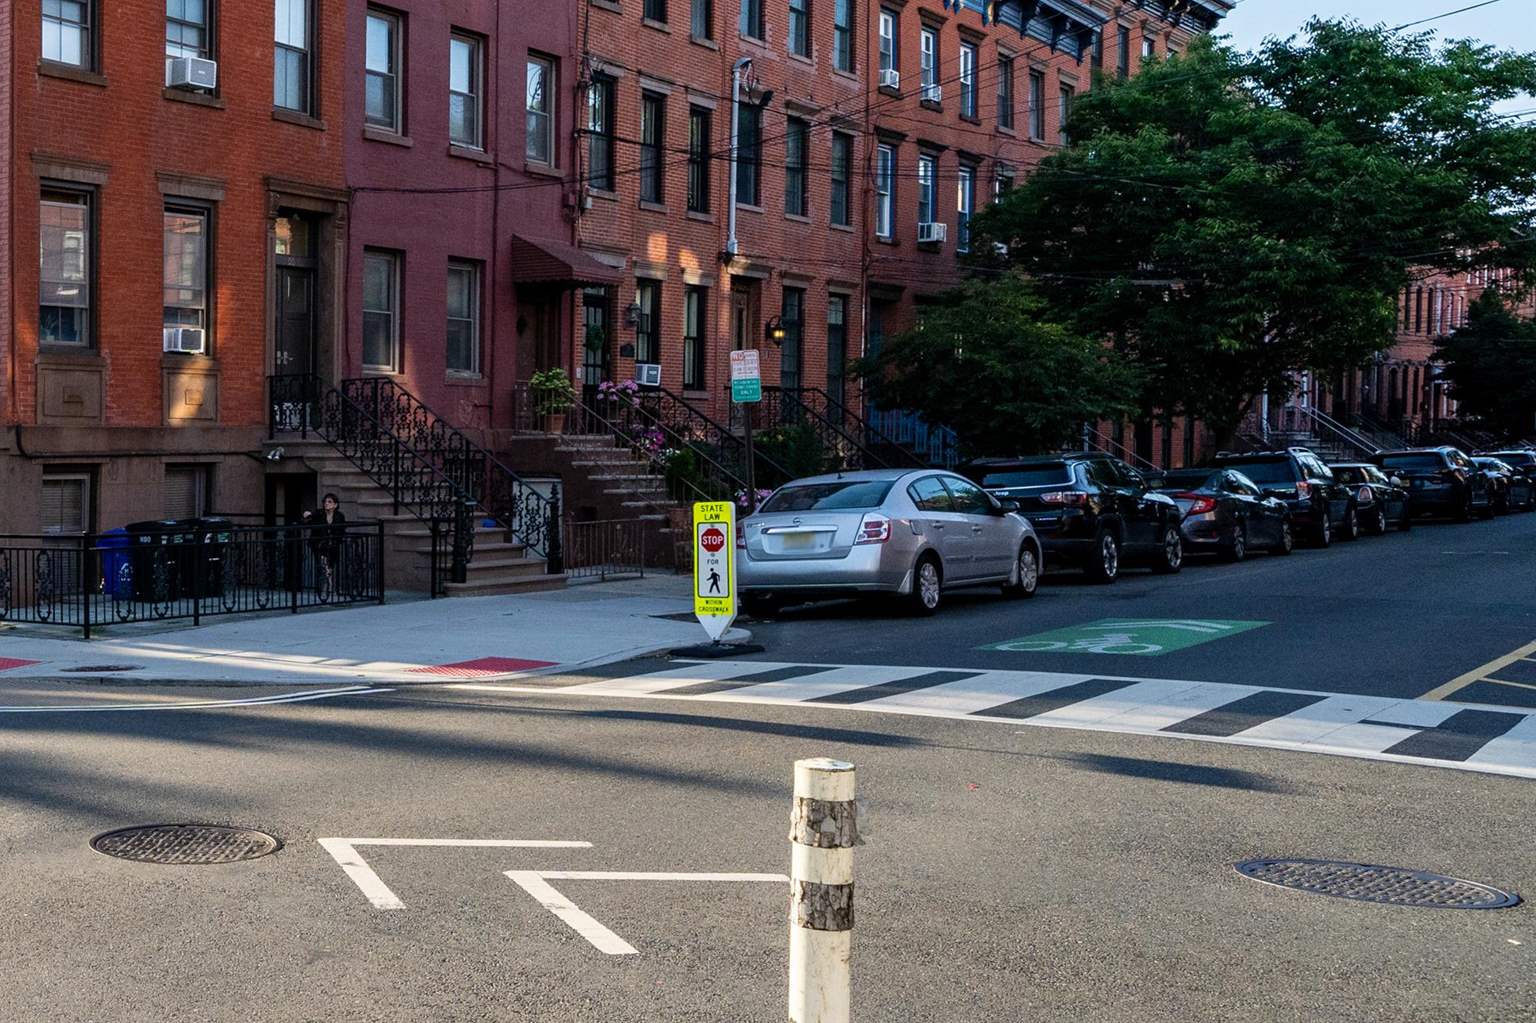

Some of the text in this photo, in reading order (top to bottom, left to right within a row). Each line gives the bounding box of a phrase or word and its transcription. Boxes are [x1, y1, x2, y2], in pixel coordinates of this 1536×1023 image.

[700, 504, 724, 513] STATE
[703, 513, 721, 521] LAW
[702, 535, 724, 546] STOP
